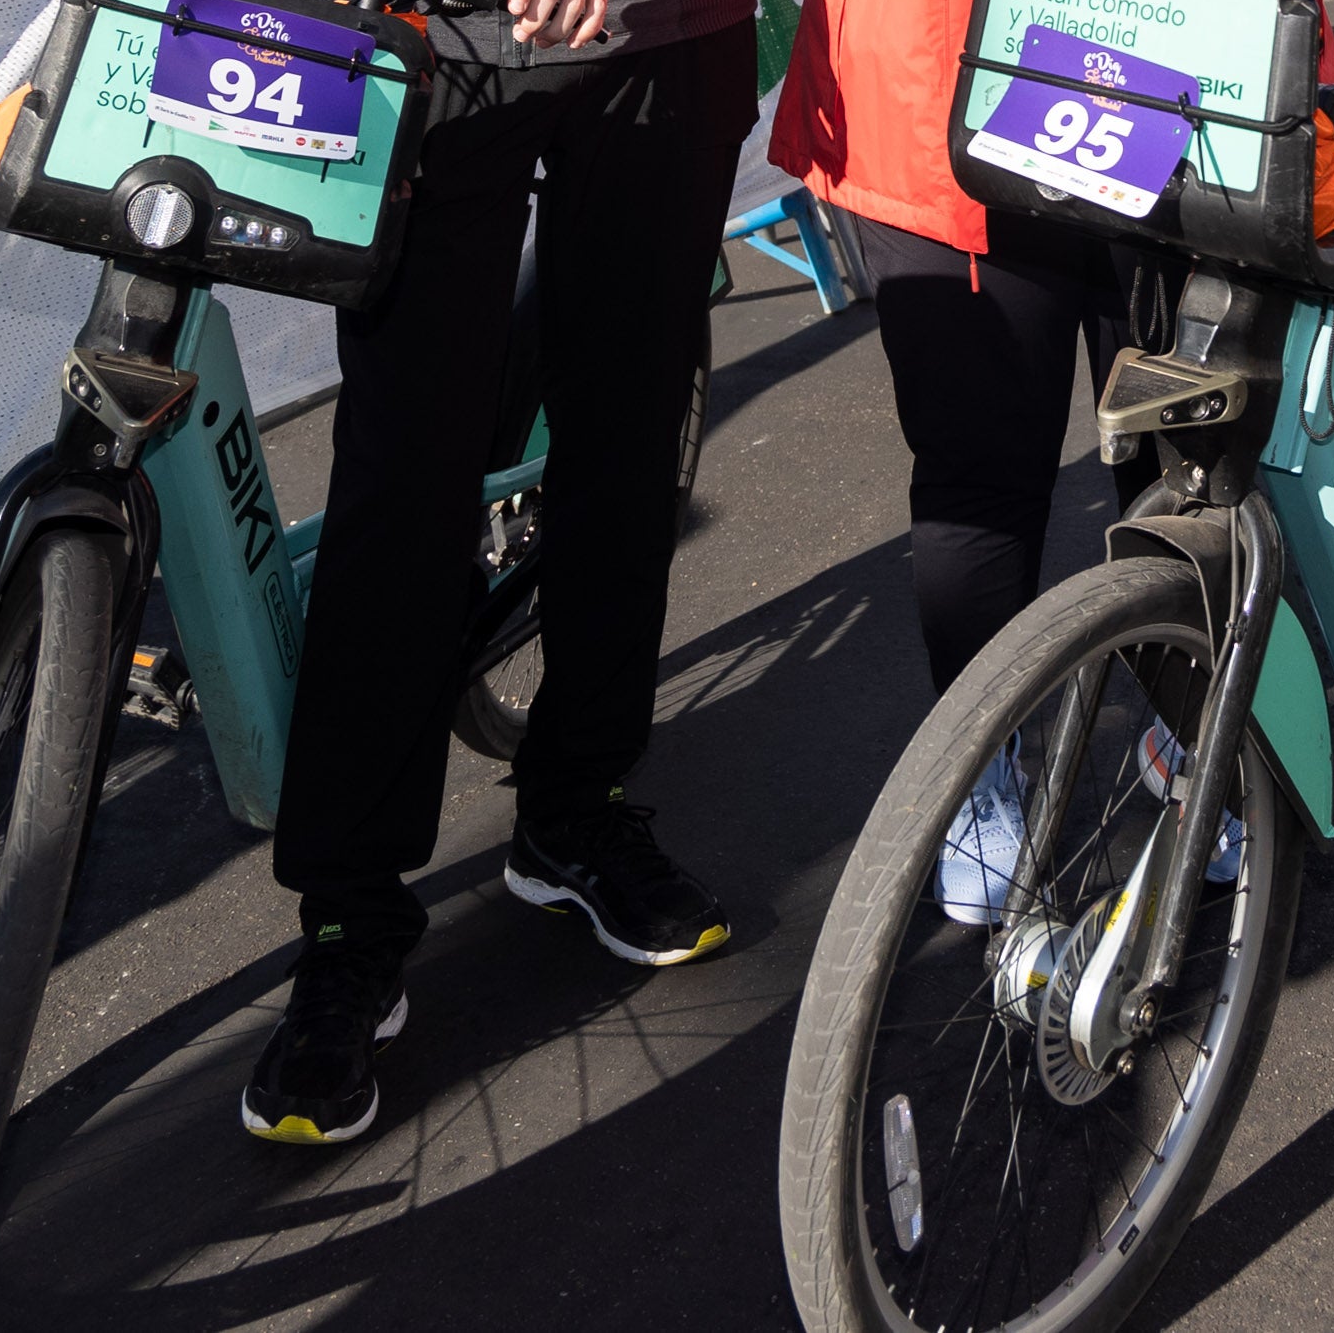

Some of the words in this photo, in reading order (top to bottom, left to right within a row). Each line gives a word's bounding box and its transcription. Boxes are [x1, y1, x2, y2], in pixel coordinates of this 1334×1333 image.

[1009, 8, 1023, 31] y
[116, 29, 144, 56] Tú
[105, 62, 122, 85] y
[207, 58, 304, 126] 94
[1198, 76, 1244, 101] BIKI
[1033, 99, 1135, 172] 95
[215, 408, 276, 576] BIKI
